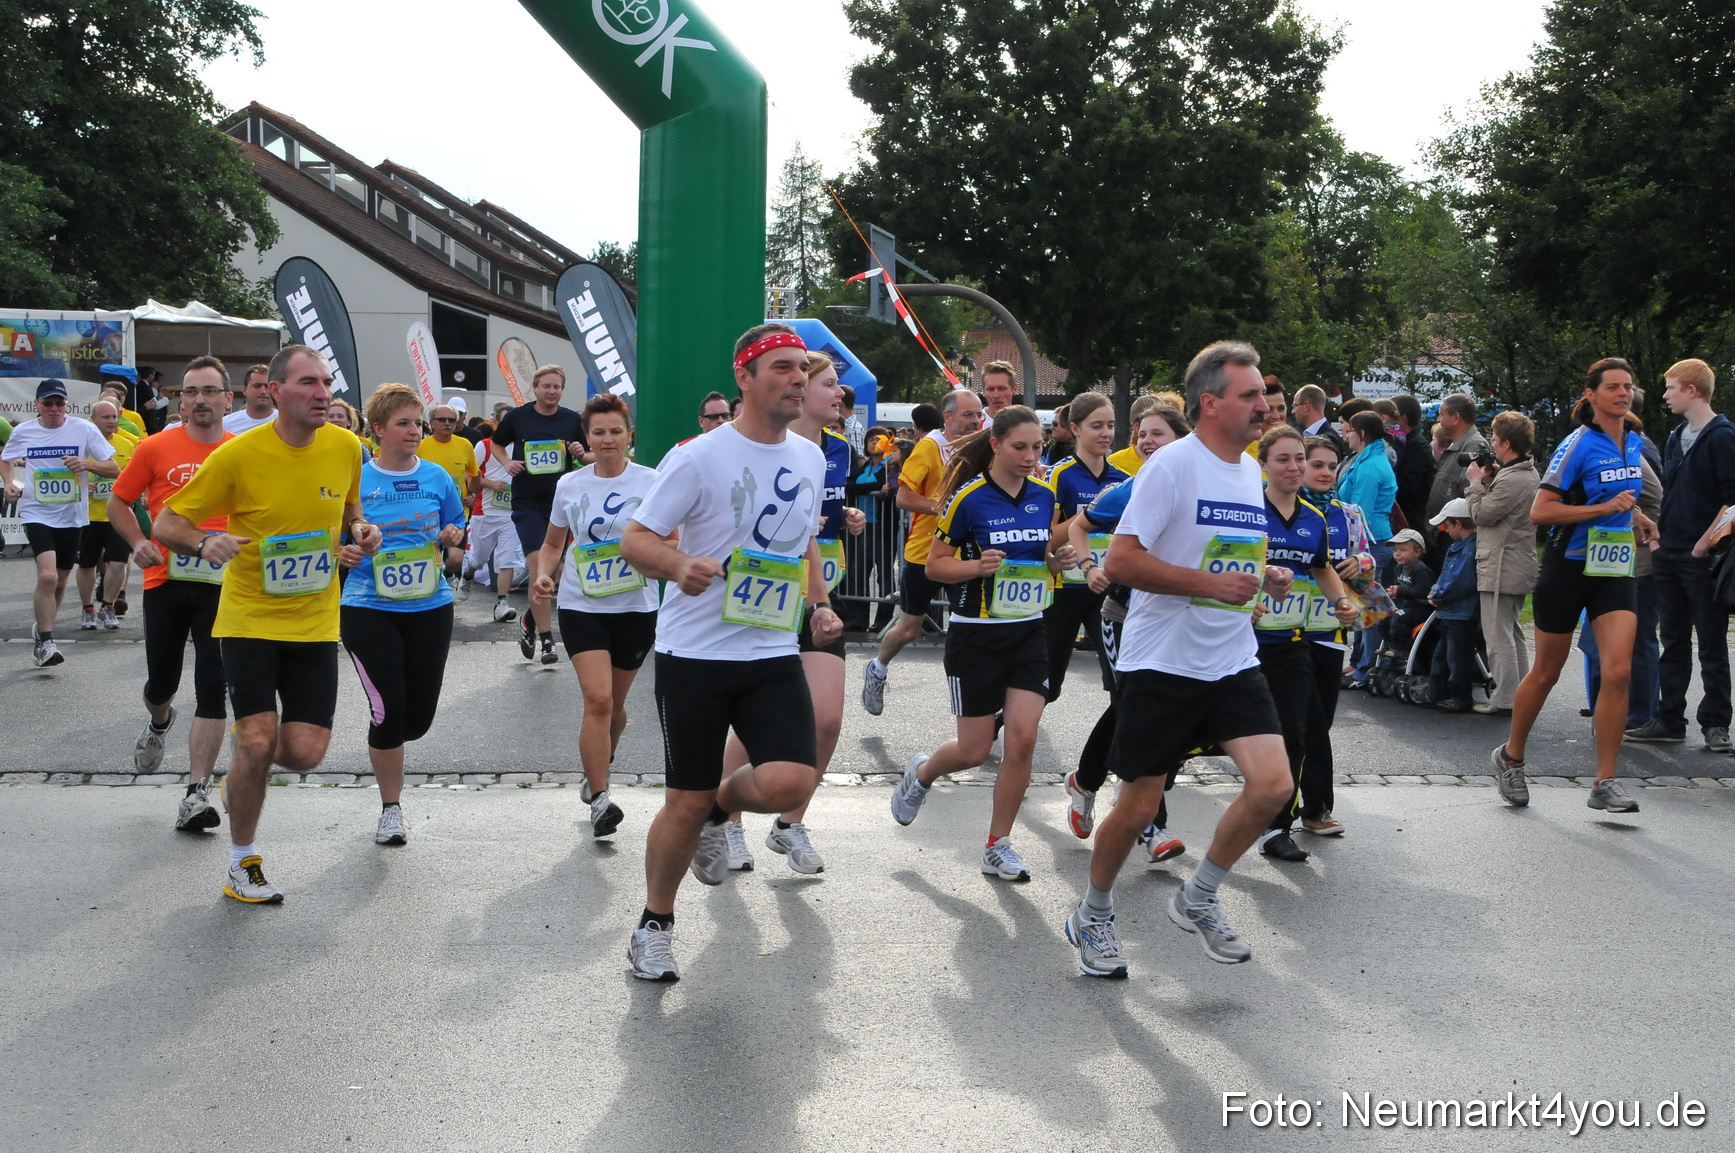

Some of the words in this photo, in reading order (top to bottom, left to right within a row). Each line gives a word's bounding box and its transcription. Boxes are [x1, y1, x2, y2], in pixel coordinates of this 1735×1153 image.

[42, 343, 108, 362] Logistics
[33, 449, 76, 457] STAEDTLER
[530, 451, 558, 466] 549
[1598, 457, 1622, 465] TEAM
[1600, 465, 1642, 483] BOCK
[39, 480, 71, 495] 900
[495, 491, 512, 503] 86
[986, 517, 1016, 526] TEAM
[989, 528, 1049, 545] BOCK
[1589, 543, 1631, 564] 1068
[265, 552, 331, 581] 1274
[382, 561, 428, 588] 687
[586, 556, 633, 583] 472
[281, 581, 299, 589] Frank
[733, 576, 789, 611] 471
[996, 580, 1044, 604] 1081
